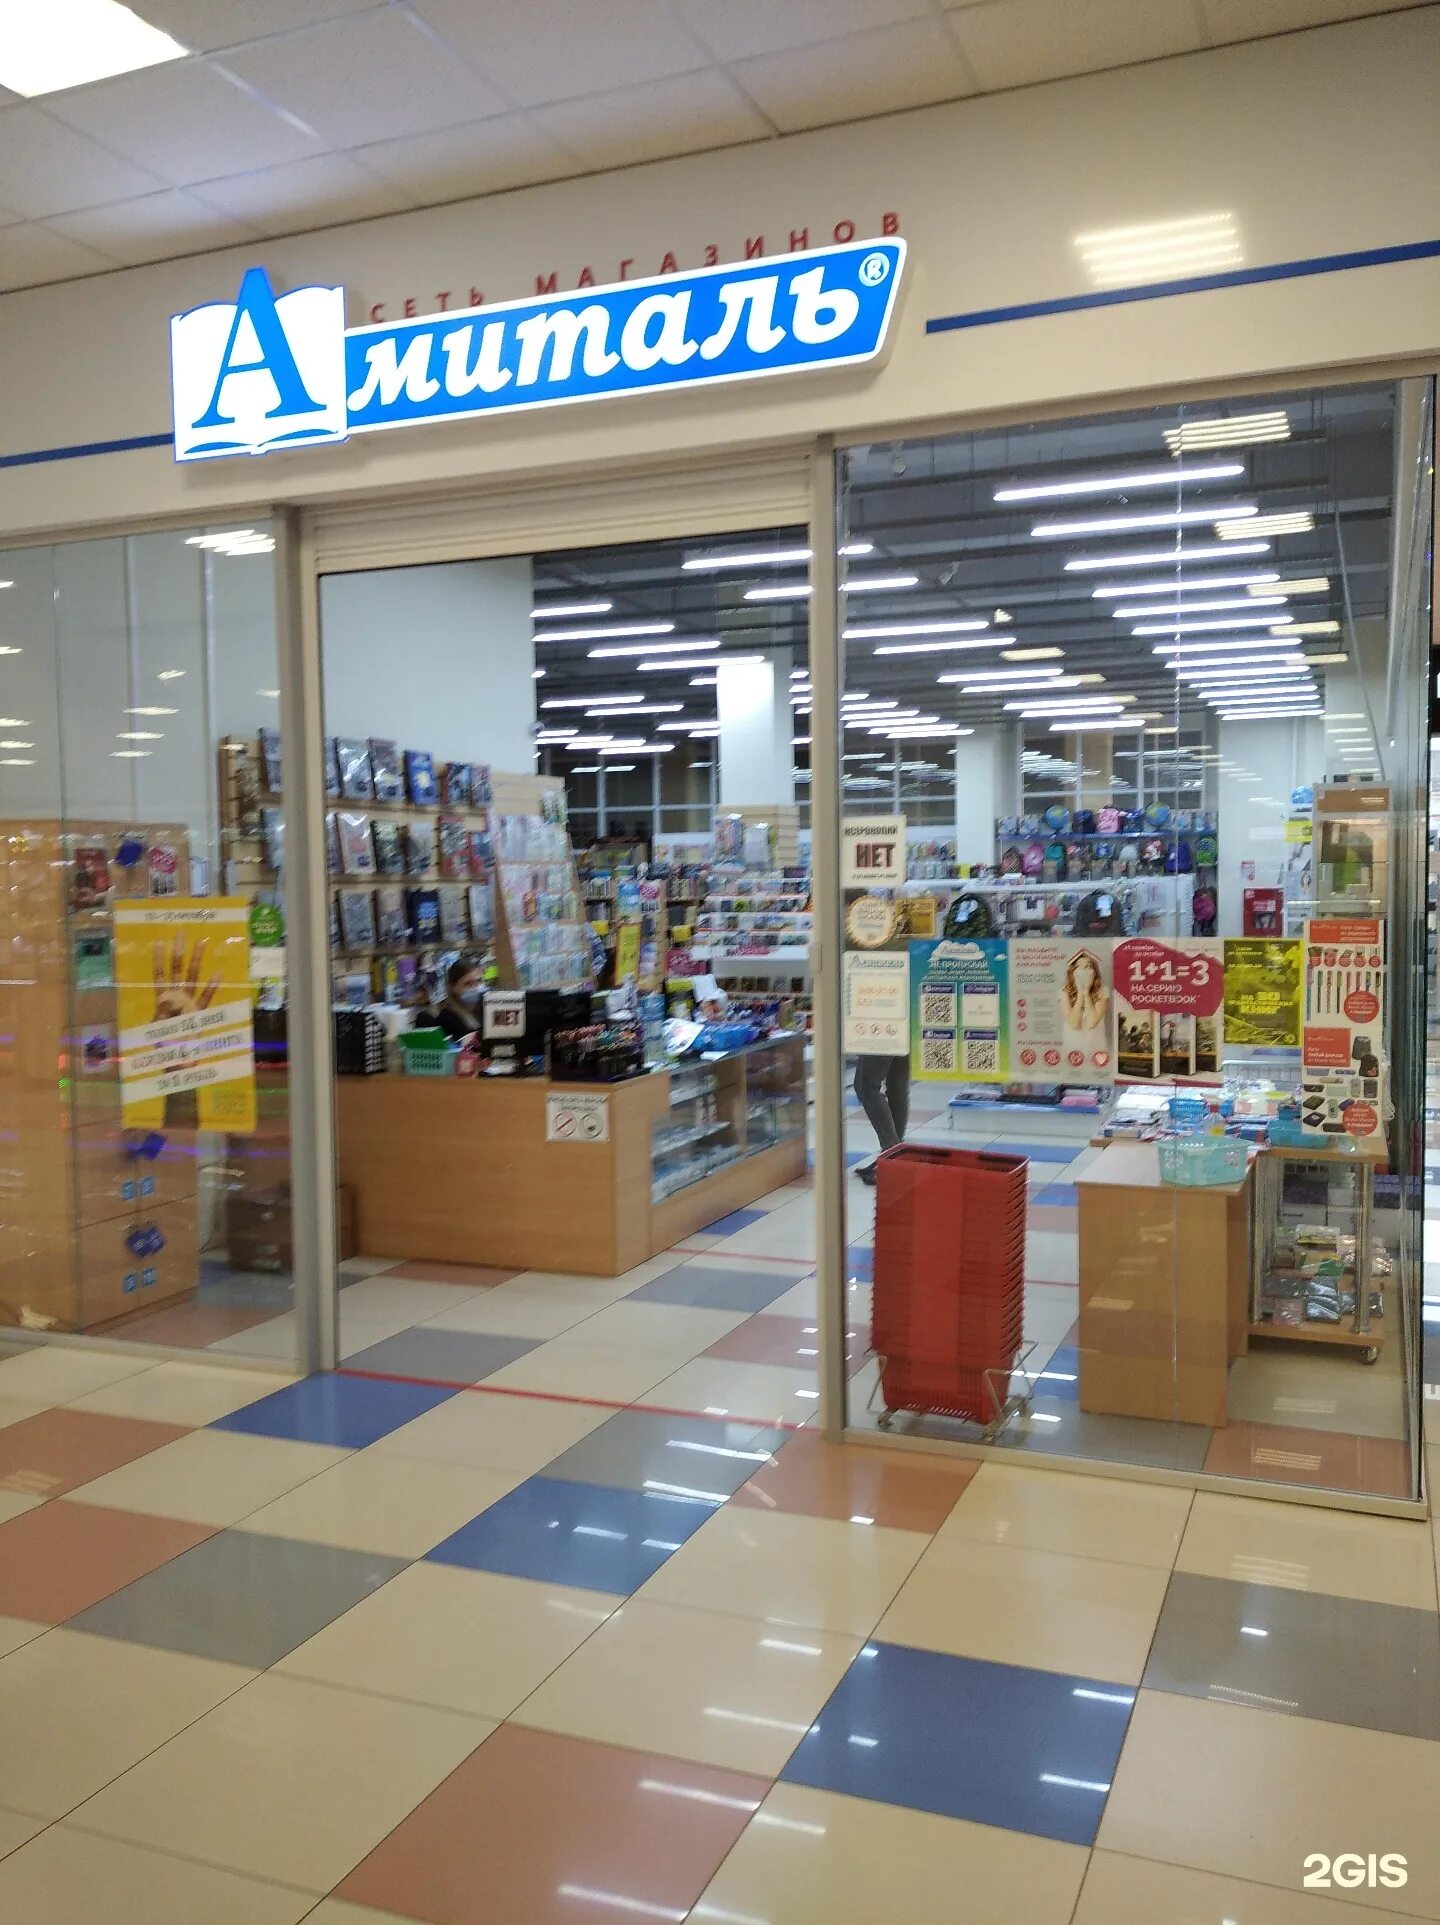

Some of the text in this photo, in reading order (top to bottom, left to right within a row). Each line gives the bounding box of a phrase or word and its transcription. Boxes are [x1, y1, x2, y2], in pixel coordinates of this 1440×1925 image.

[370, 211, 900, 325] СЕТЬ МАГАЗИНОВ
[856, 843, 896, 868] НЕТ
[1128, 959, 1210, 986] 1+1=3
[1131, 984, 1183, 993] НА СЕРИЮ
